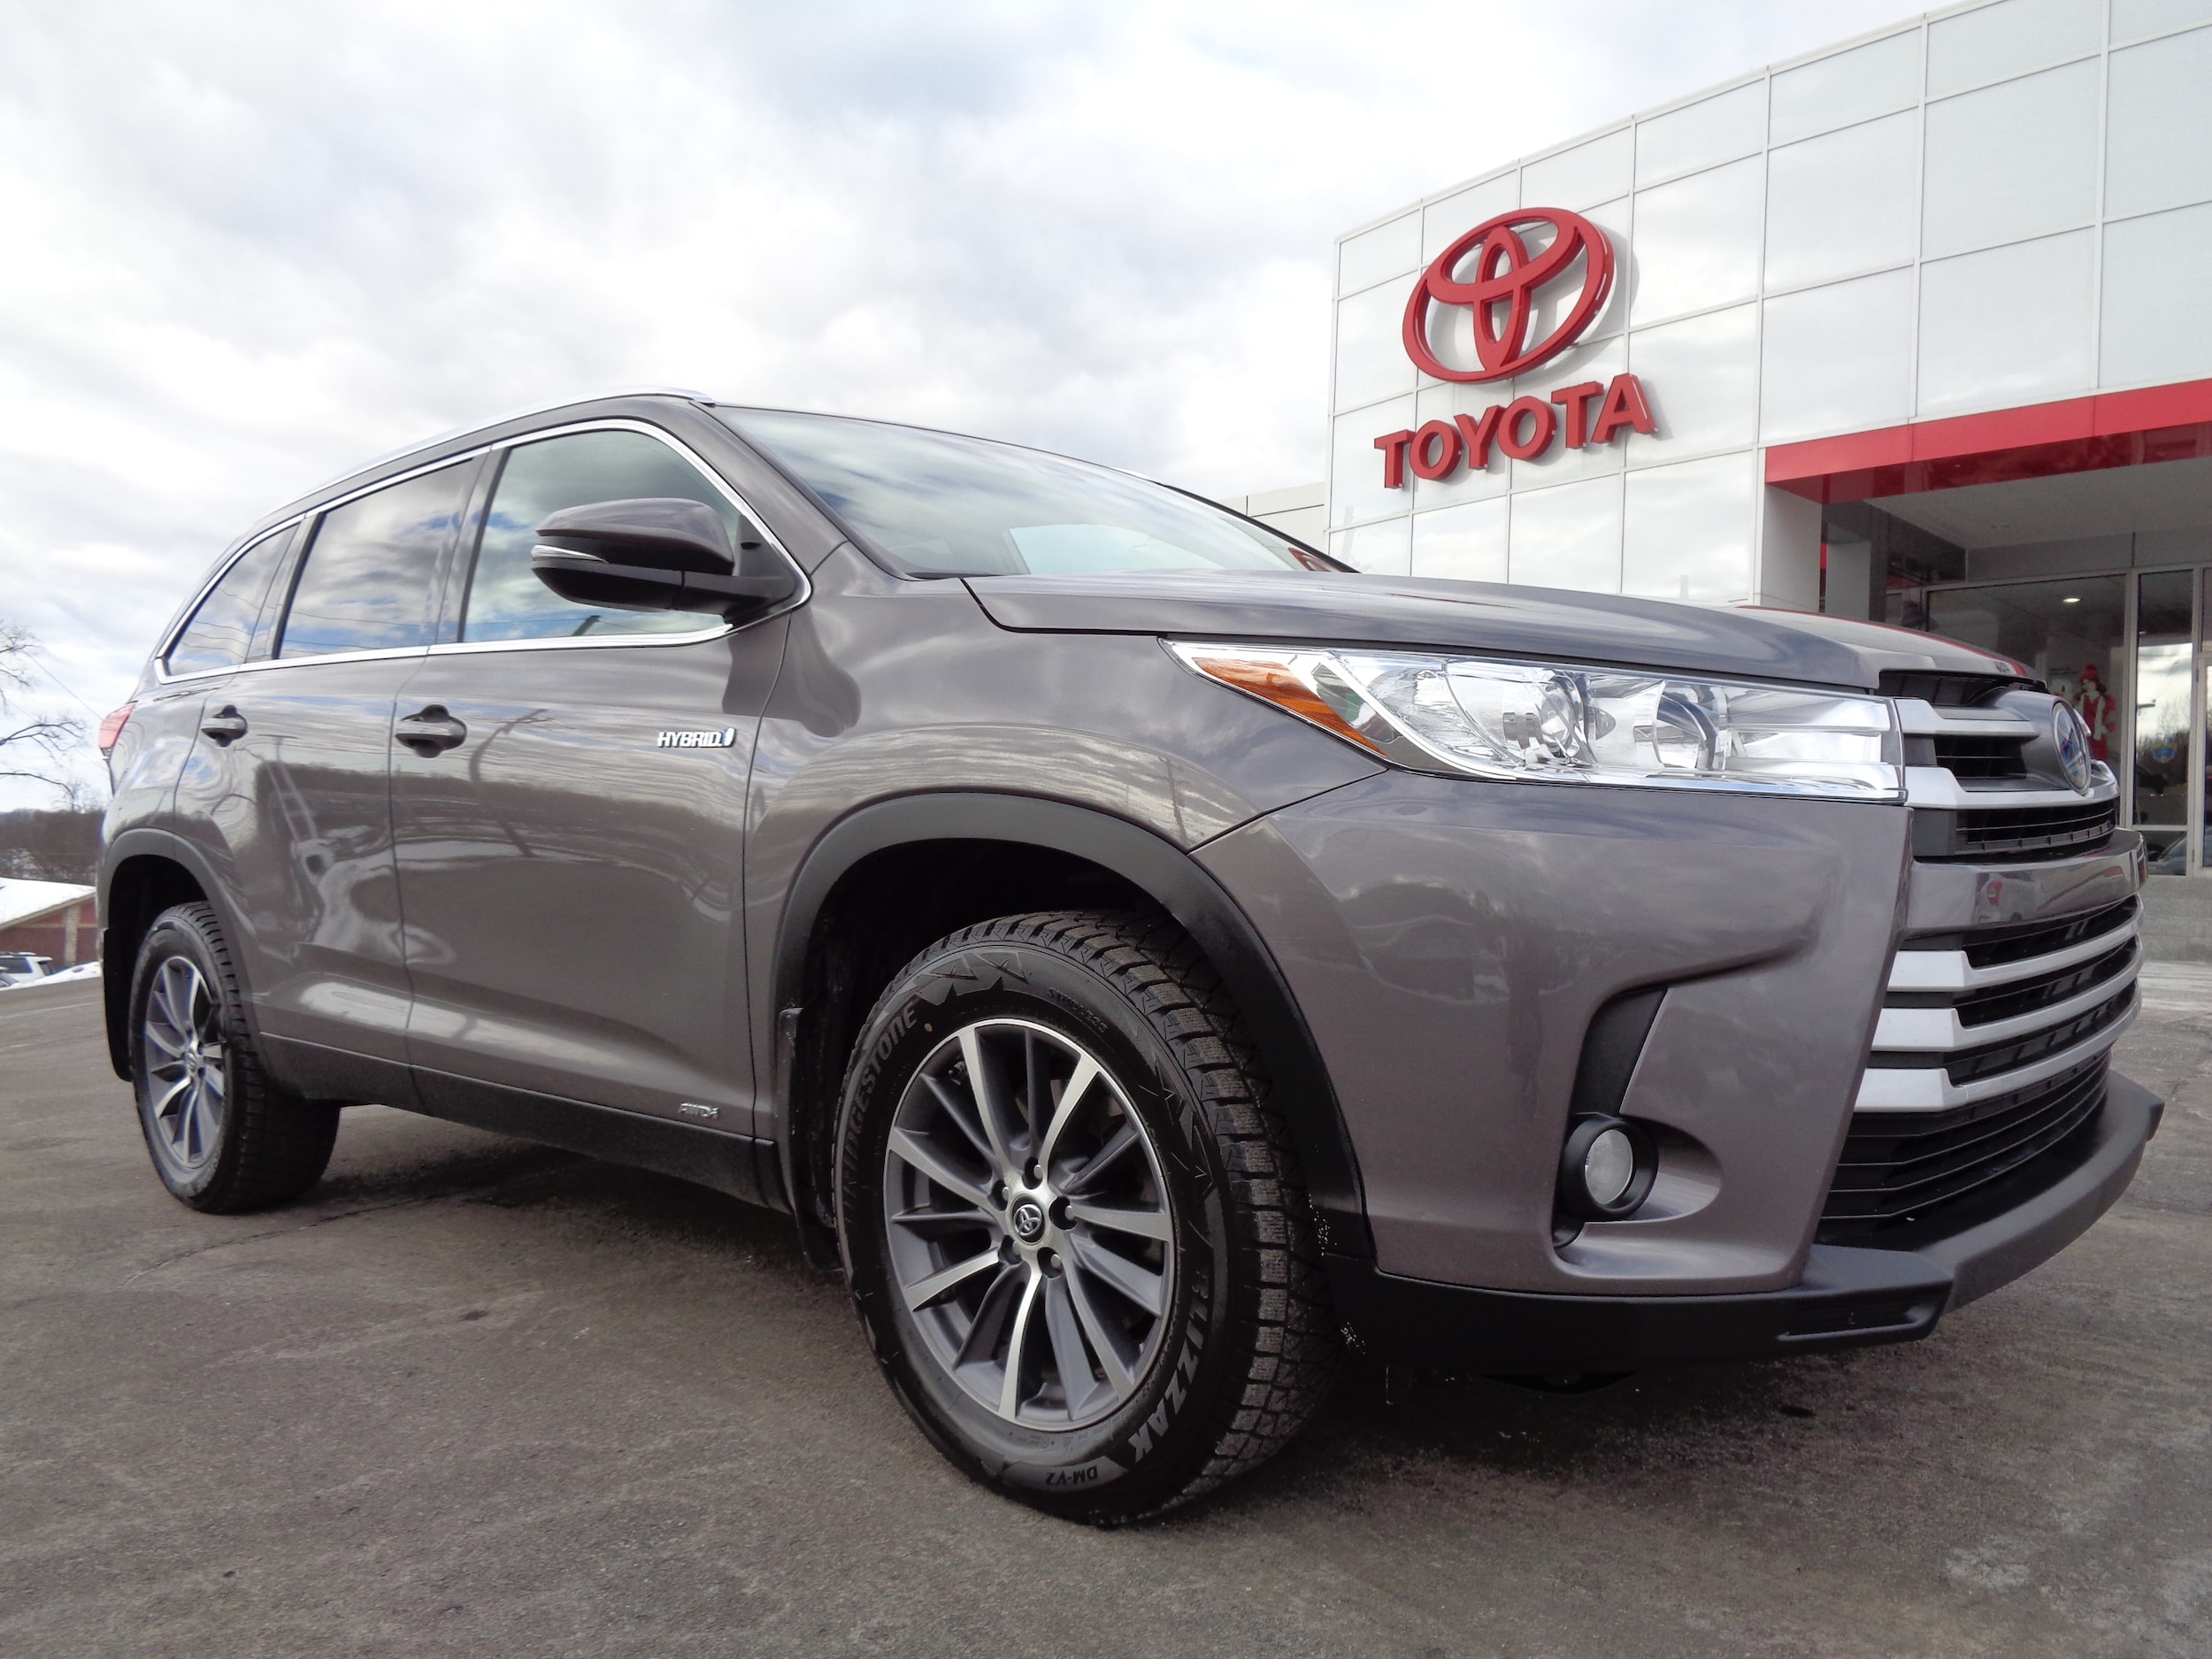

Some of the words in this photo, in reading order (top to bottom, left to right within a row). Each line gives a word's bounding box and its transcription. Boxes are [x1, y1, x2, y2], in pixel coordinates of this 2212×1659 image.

[1374, 373, 1657, 488] TOYOTA
[657, 731, 722, 748] HYBRID
[1046, 1464, 1098, 1486] DM-V2
